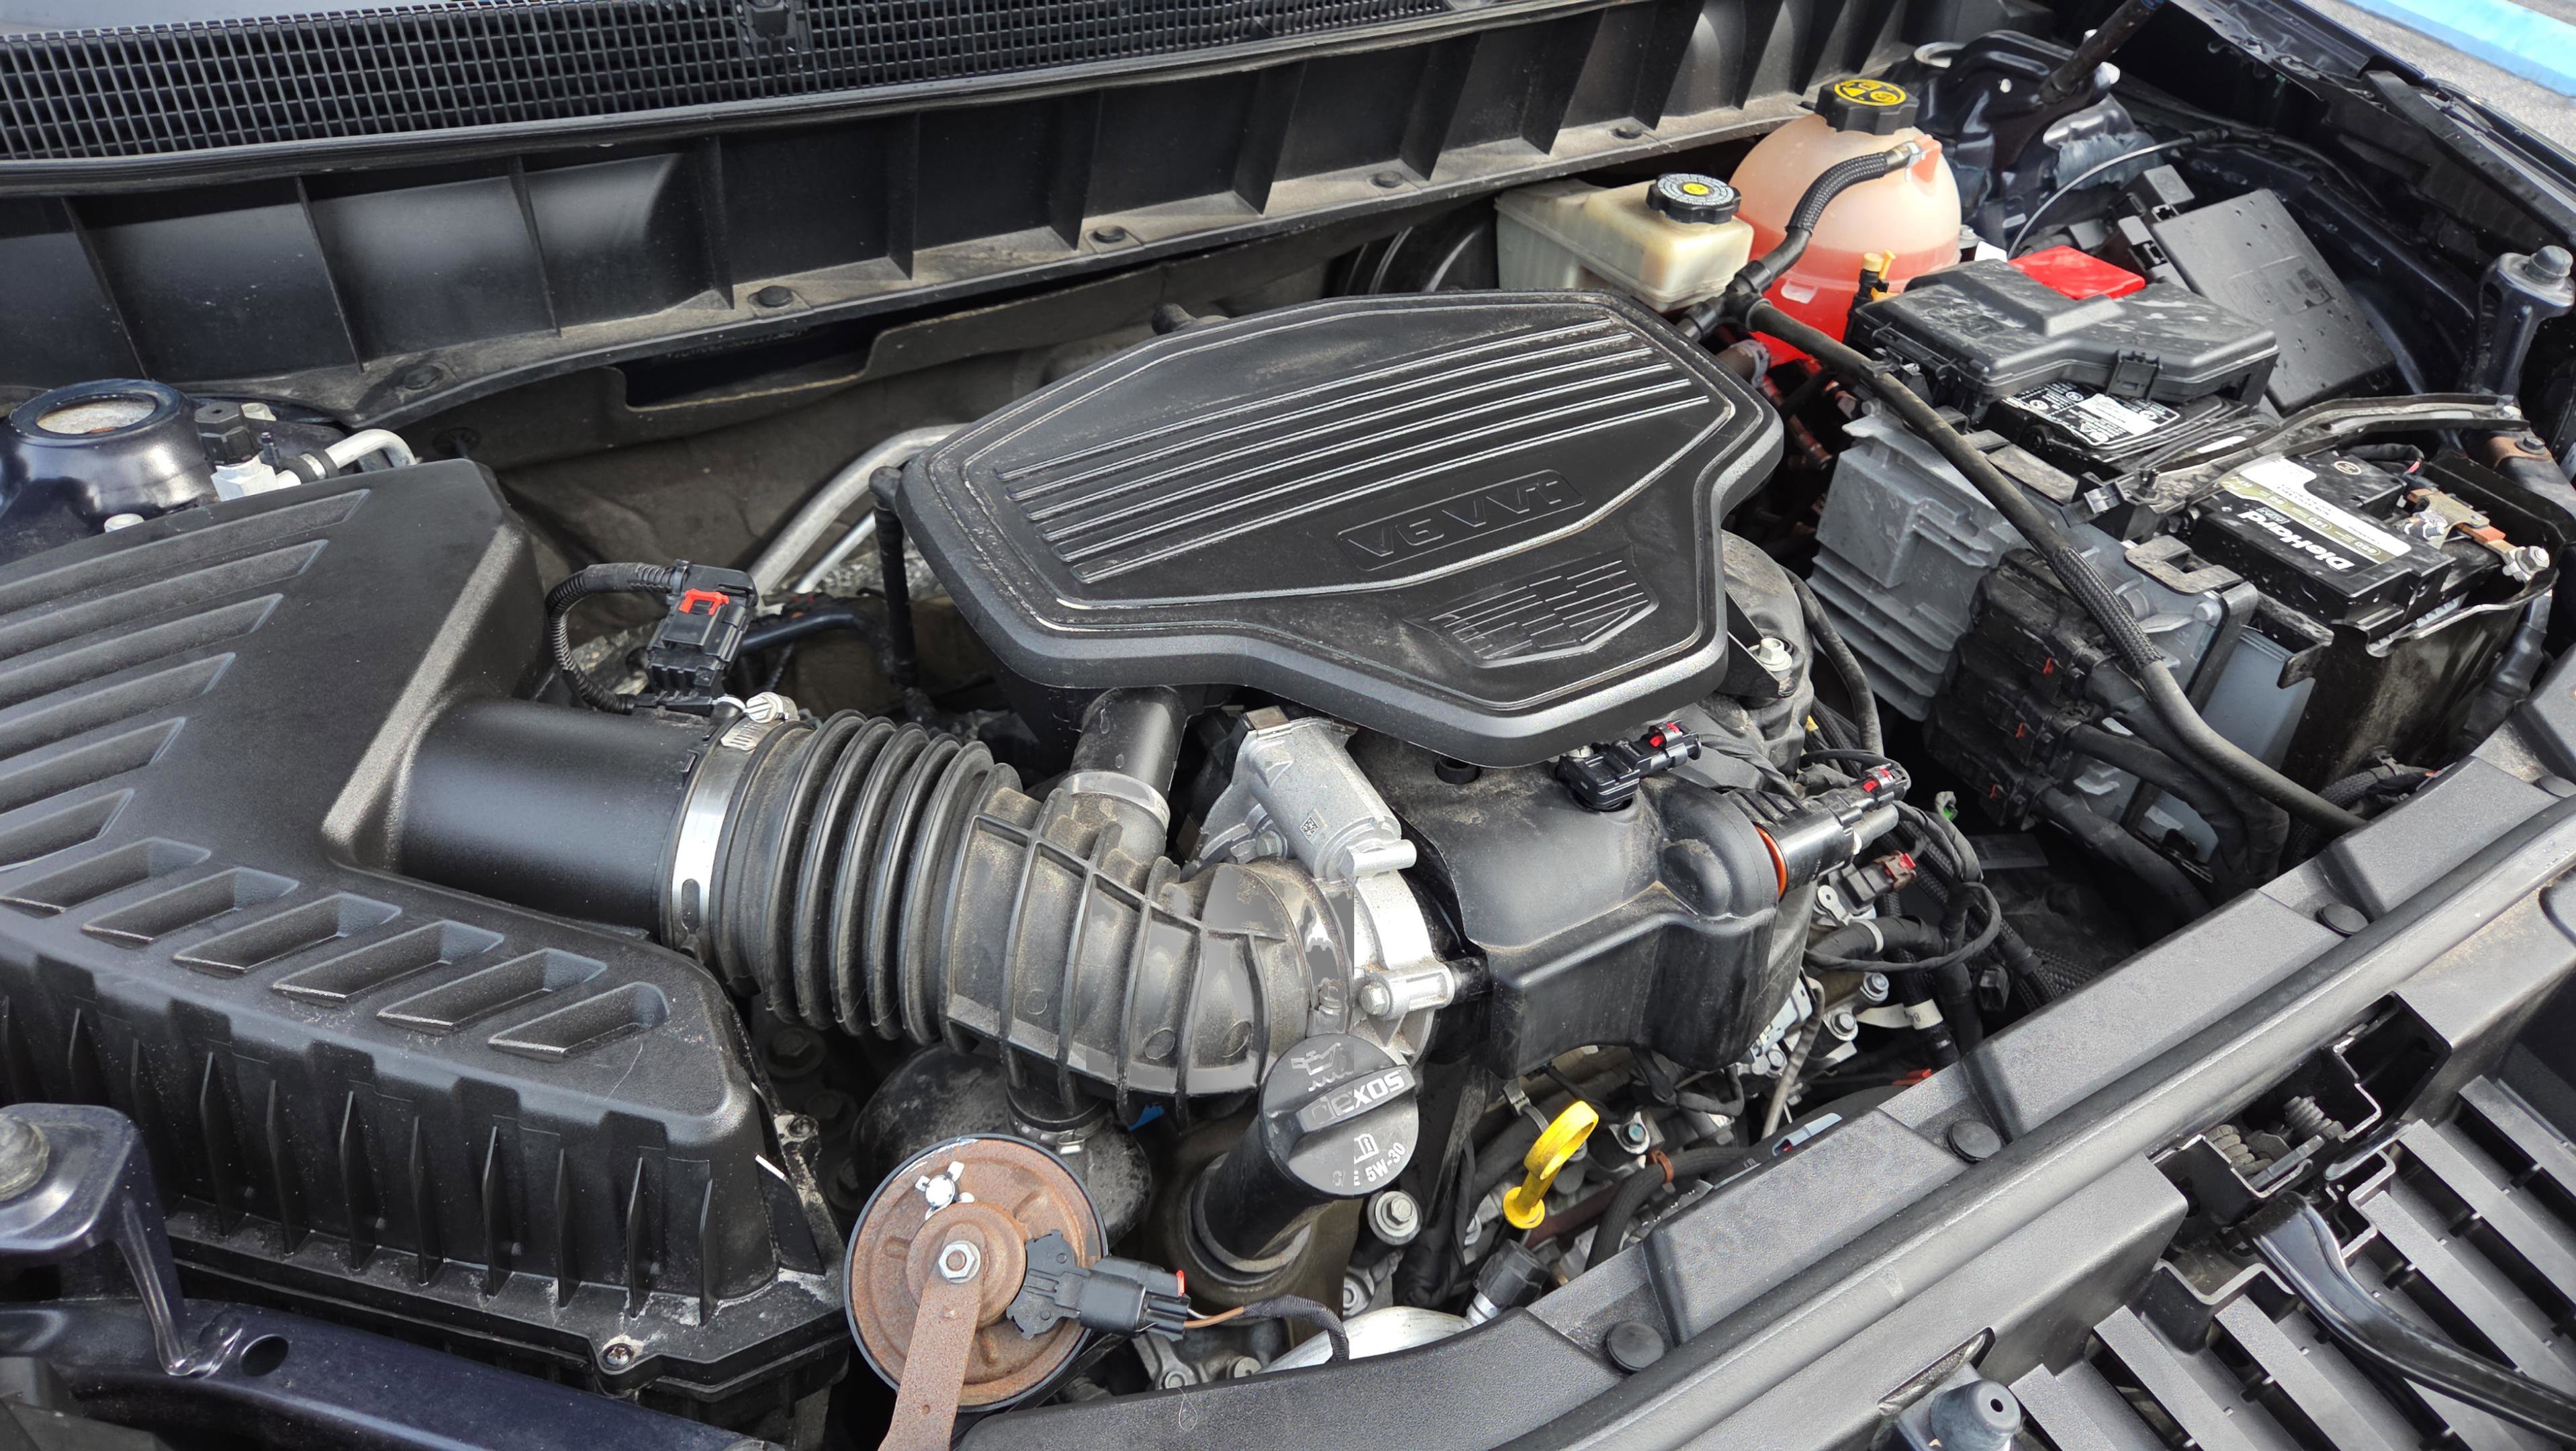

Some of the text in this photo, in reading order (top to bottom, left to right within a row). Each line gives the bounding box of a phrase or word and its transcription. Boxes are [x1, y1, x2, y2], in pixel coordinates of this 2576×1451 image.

[1346, 515, 1444, 558] V6
[2237, 511, 2356, 570] DieHard
[1365, 1142, 1406, 1182] 5W-30
